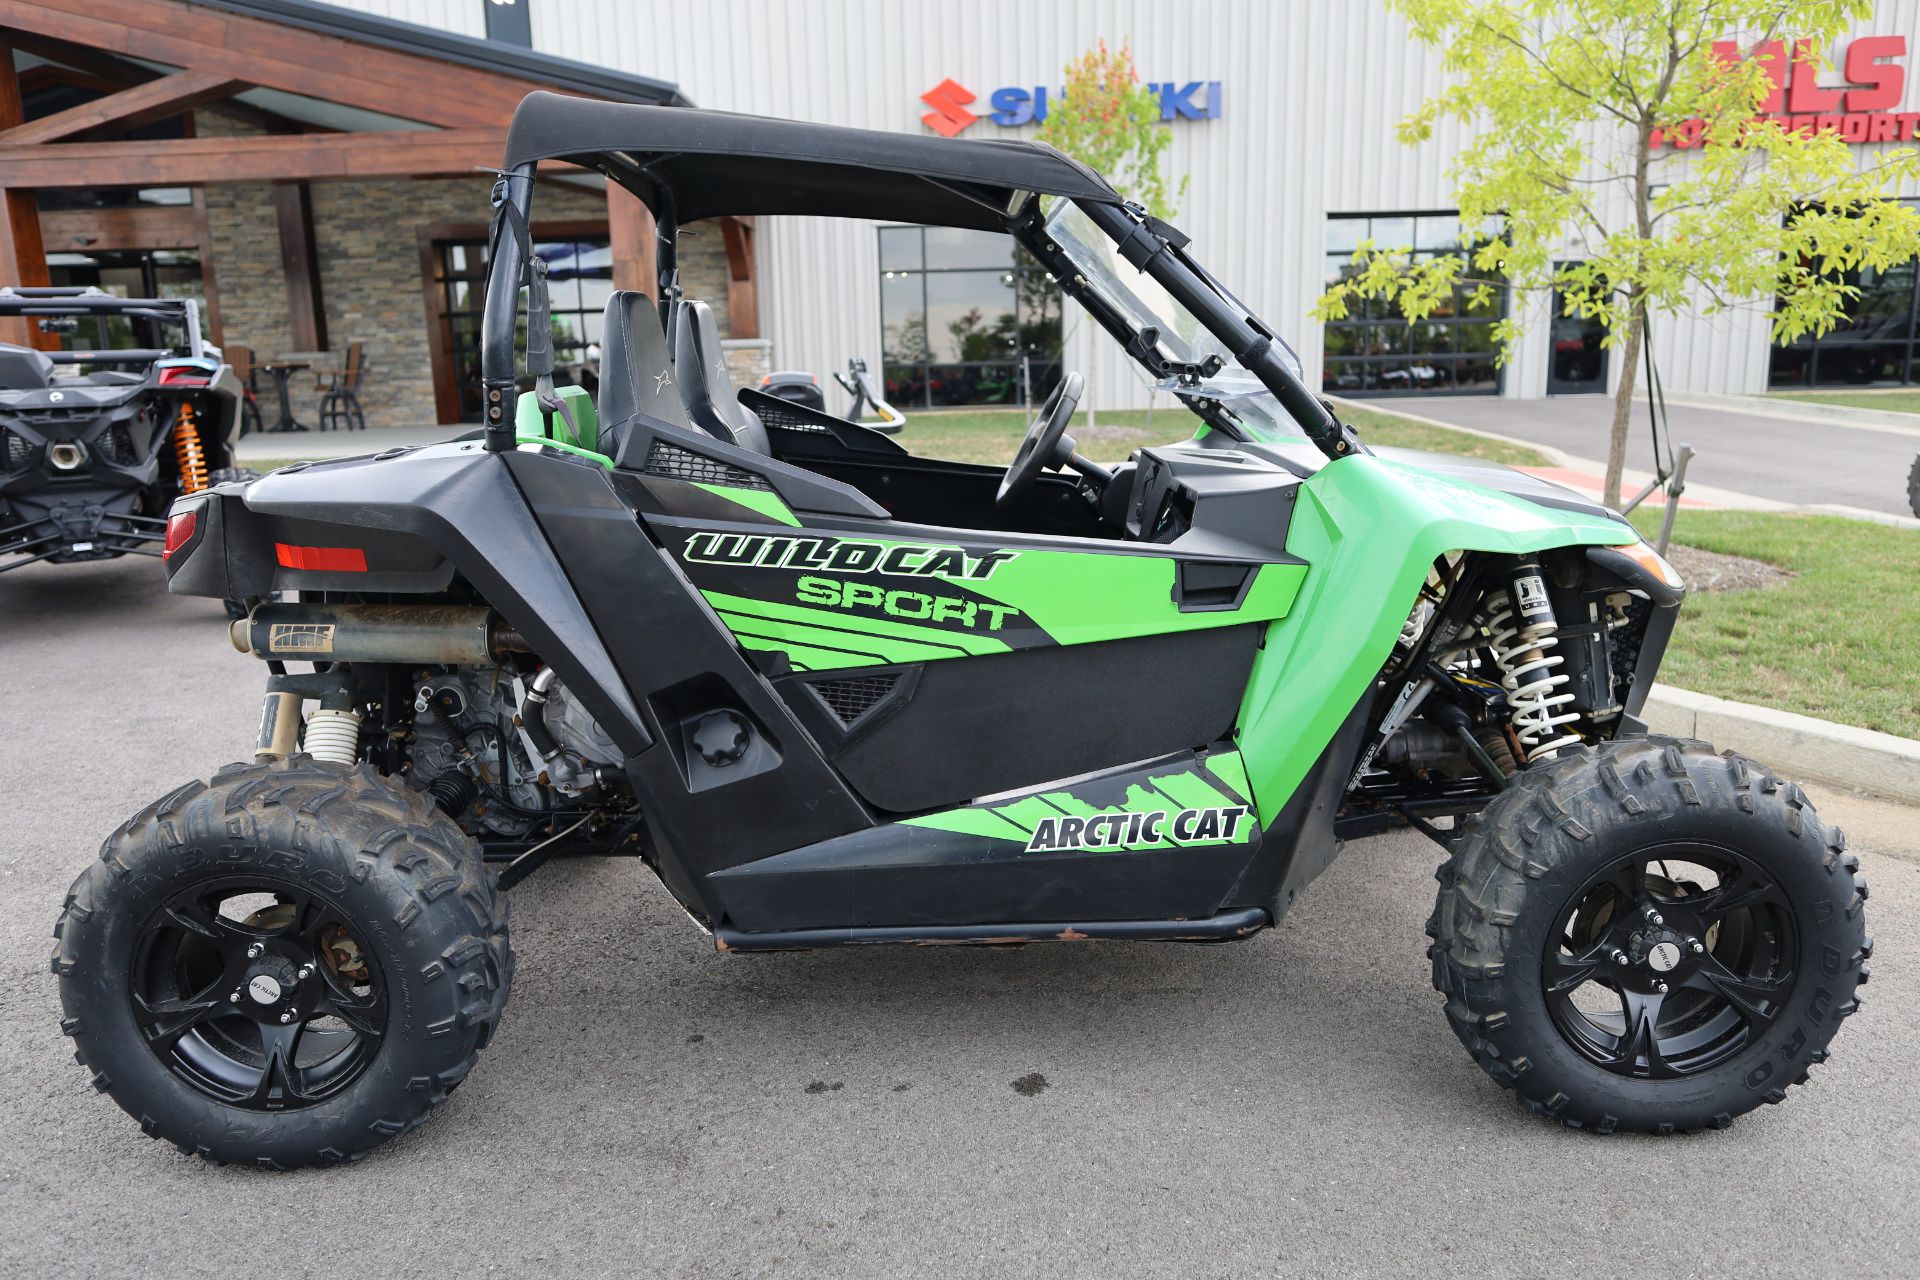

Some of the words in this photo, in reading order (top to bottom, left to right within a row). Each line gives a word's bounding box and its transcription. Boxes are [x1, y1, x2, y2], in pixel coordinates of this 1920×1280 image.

[990, 80, 1221, 127] SUKI
[1648, 111, 1920, 149] POSPORT
[683, 532, 1022, 580] WILDCAT
[795, 574, 1019, 630] SPORT
[1024, 810, 1168, 853] ARCTIC
[1171, 805, 1248, 843] CAT
[1744, 942, 1842, 1090] DURO
